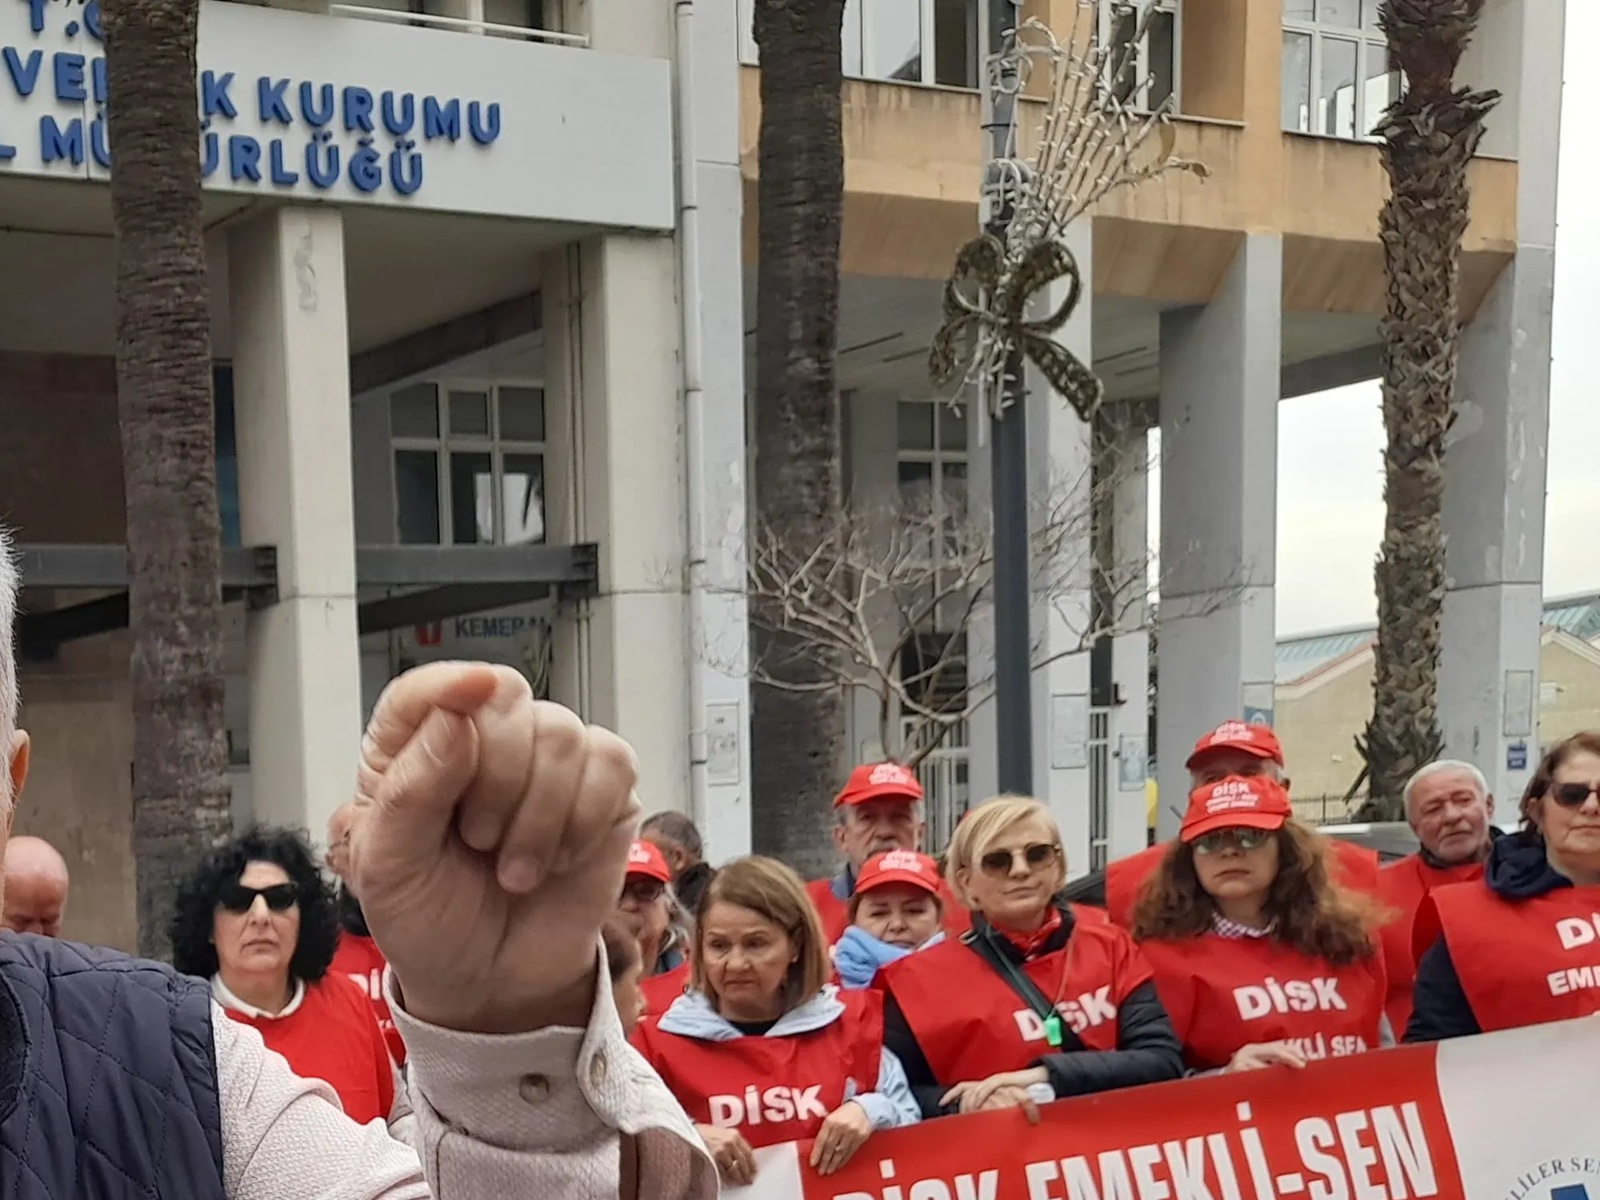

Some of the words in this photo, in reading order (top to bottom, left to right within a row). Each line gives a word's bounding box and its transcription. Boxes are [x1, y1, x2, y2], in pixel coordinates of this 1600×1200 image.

[258, 76, 501, 146] KURUMU
[41, 113, 424, 195] MÜÜRLÜĞÜ
[1012, 985, 1117, 1041] DSK
[1233, 976, 1347, 1021] DİSK
[708, 1084, 828, 1128] DİSK
